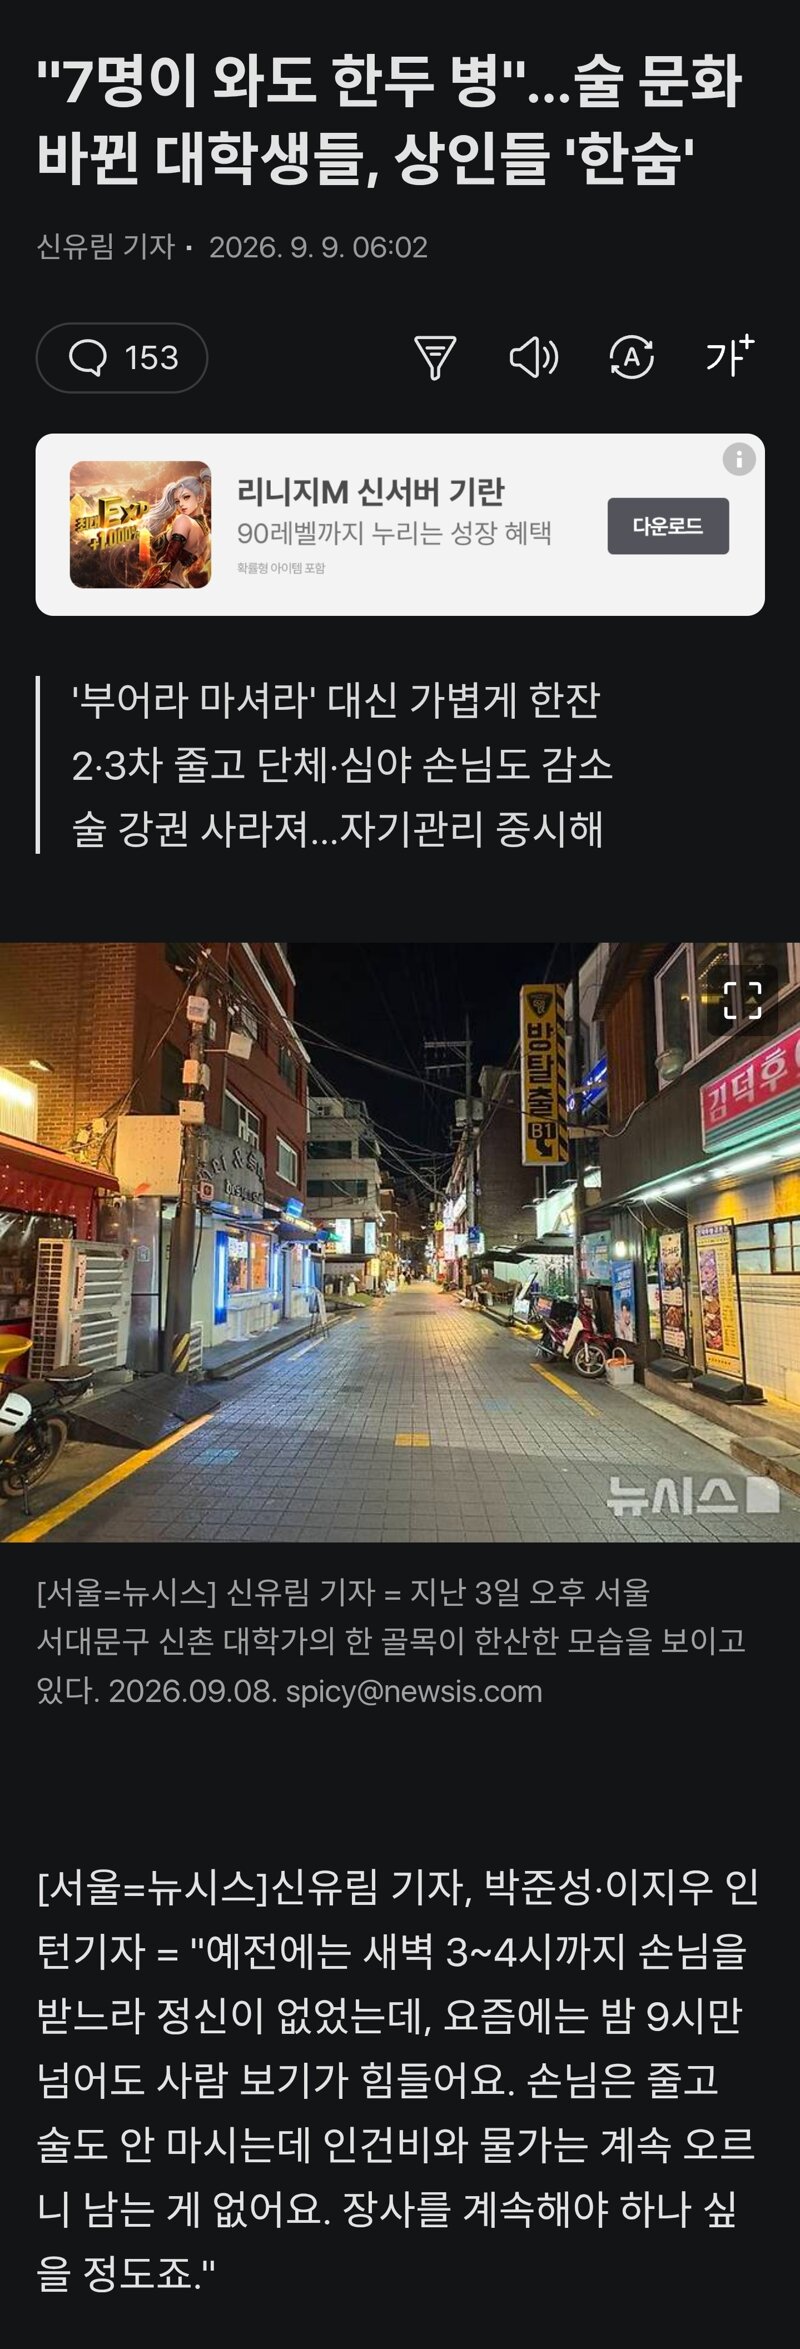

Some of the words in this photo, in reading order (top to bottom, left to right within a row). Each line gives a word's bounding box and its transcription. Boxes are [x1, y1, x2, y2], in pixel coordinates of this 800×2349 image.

[38, 53, 194, 108] "7명이
[214, 53, 316, 108] 와도
[332, 54, 434, 108] 한두
[639, 54, 742, 108] 문화
[39, 131, 138, 185] 바뀐
[157, 131, 378, 188] 대학생들,
[395, 131, 550, 185] 상인들
[566, 131, 693, 185] '한숨'
[37, 233, 112, 260] 신유림
[124, 233, 175, 260] 기자
[210, 236, 282, 258] 2026.
[291, 236, 313, 258] 9.
[322, 236, 344, 258] 9.
[353, 236, 427, 258] 06:02
[126, 345, 178, 370] 153
[239, 477, 348, 507] 리니지M
[358, 477, 438, 507] 신서버
[450, 477, 505, 507] 기란
[238, 521, 362, 545] 90레벨까지
[372, 521, 443, 546] 누리는
[451, 521, 498, 545] 성장
[505, 521, 550, 545] 혜택
[634, 517, 703, 536] 다운로드
[239, 563, 267, 574] 확률형
[271, 563, 301, 574] 아이템
[306, 563, 324, 574] 포함
[73, 682, 189, 719] '부어라
[202, 682, 315, 719] 마셔라'
[329, 682, 396, 719] 대신
[411, 682, 515, 719] 가볍게
[530, 682, 600, 718] 한잔
[175, 747, 245, 783] 줄고
[423, 746, 530, 783] 손님도
[543, 747, 613, 783] 감소
[73, 811, 106, 847] 술
[119, 811, 187, 847] 강권
[497, 811, 601, 848] 중시해
[527, 1022, 555, 1118] 방탈출
[708, 1038, 800, 1122] 김덕후
[531, 1122, 554, 1139] B1
[38, 1578, 215, 1608] [서울=뉴시스]
[227, 1578, 307, 1607] 신유림
[321, 1578, 375, 1607] 기자
[385, 1591, 400, 1600] =
[411, 1578, 466, 1607] 지난
[476, 1578, 518, 1607] 3일
[530, 1578, 585, 1607] 오후
[595, 1578, 649, 1607] 서울
[37, 1627, 149, 1656] 서대문구
[160, 1627, 213, 1655] 신촌
[225, 1627, 333, 1656] 대학가의
[346, 1627, 372, 1655] 한
[382, 1627, 462, 1656] 골목이
[475, 1627, 559, 1655] 한산한
[568, 1628, 652, 1656] 모습을
[662, 1627, 745, 1655] 보이고
[38, 1676, 99, 1704] 있다.
[110, 1679, 276, 1703] 2026.09.08.
[287, 1679, 541, 1708] spicy@newsis.com
[39, 1869, 376, 1907] [서울=뉴시스]신유림
[392, 1869, 471, 1907] 기자,
[726, 1869, 757, 1905] 인
[39, 1933, 146, 1970] 턴기자
[158, 1950, 178, 1961] =
[192, 1933, 351, 1970] "예전에는
[364, 1933, 431, 1970] 새벽
[447, 1933, 623, 1970] 3~4시까지
[639, 1933, 746, 1970] 손님을
[39, 1997, 145, 2035] 받느라
[158, 1998, 261, 2035] 정신이
[278, 1997, 430, 2036] 없었는데,
[444, 1998, 588, 2035] 요즘에는
[603, 1998, 635, 2034] 밤
[647, 1997, 742, 2035] 9시만
[39, 2062, 144, 2099] 넘어도
[157, 2062, 228, 2099] 사람
[241, 2062, 349, 2099] 보기가
[361, 2062, 514, 2099] 힘들어요.
[527, 2062, 635, 2099] 손님은
[648, 2063, 718, 2099] 줄고
[37, 2126, 108, 2163] 술도
[121, 2126, 155, 2163] 안
[168, 2126, 309, 2164] 마시는데
[324, 2126, 468, 2164] 인건비와
[481, 2126, 588, 2164] 물가는
[601, 2127, 671, 2164] 계속
[684, 2129, 754, 2159] 오르
[40, 2191, 68, 2228] 니
[85, 2191, 154, 2228] 남는
[167, 2191, 198, 2228] 게
[214, 2191, 330, 2228] 없어요.
[344, 2191, 451, 2228] 장사를
[464, 2191, 608, 2228] 계속해야
[620, 2191, 692, 2228] 하나
[704, 2191, 735, 2228] 싶
[37, 2256, 71, 2292] 을
[84, 2256, 214, 2293] 정도죠."
